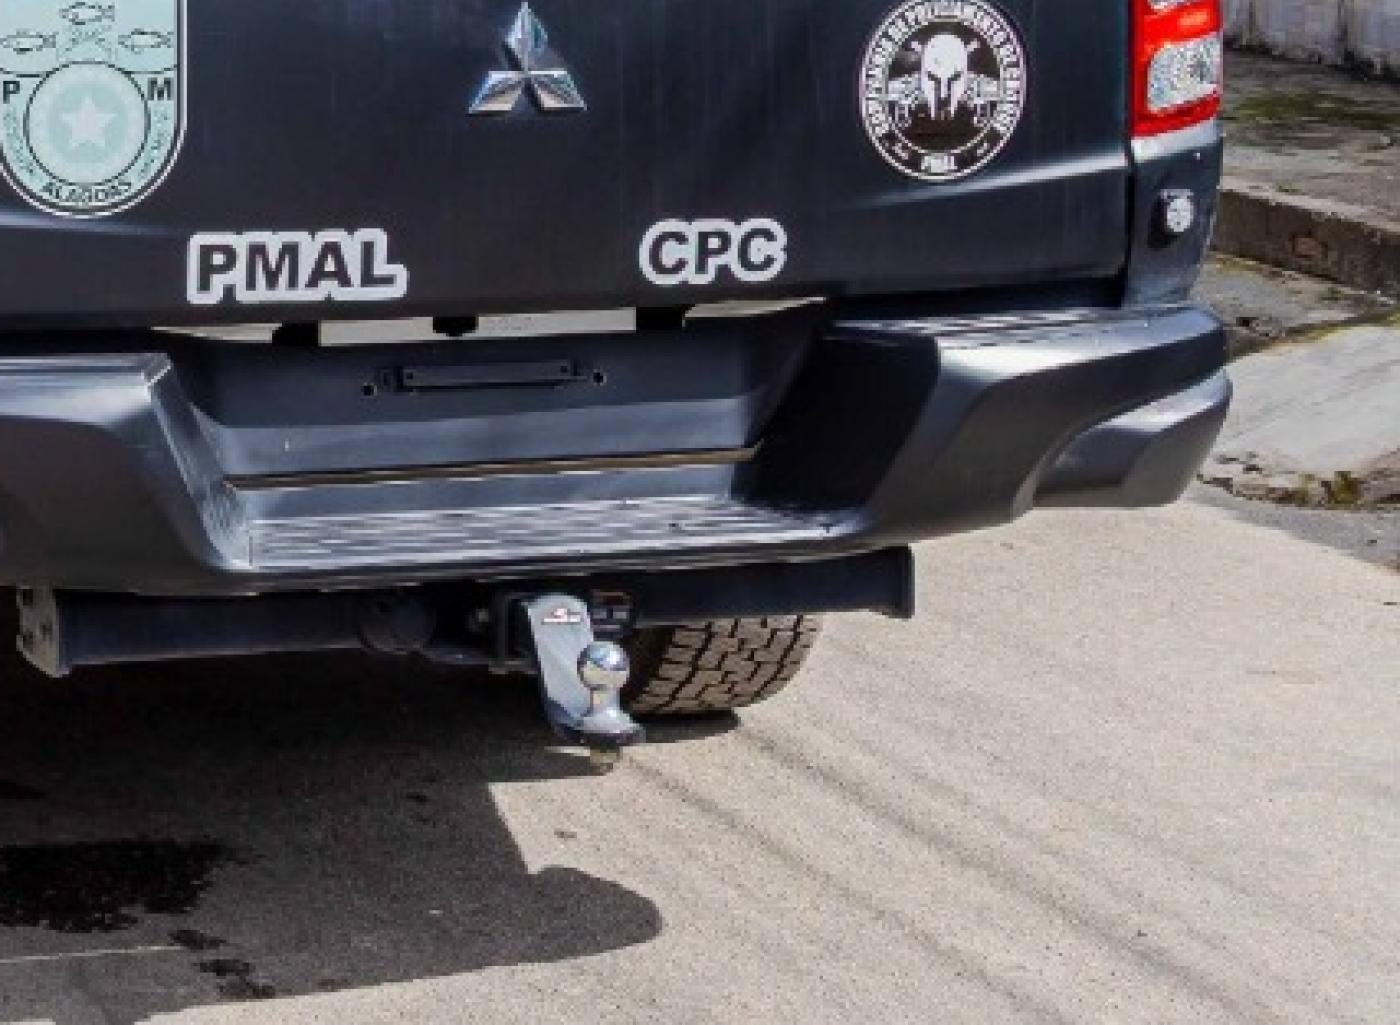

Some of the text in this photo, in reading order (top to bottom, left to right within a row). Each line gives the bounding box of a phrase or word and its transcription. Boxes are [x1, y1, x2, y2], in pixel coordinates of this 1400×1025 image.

[2, 77, 174, 104] P M
[187, 228, 408, 305] PMAL
[639, 218, 789, 285] CPC
